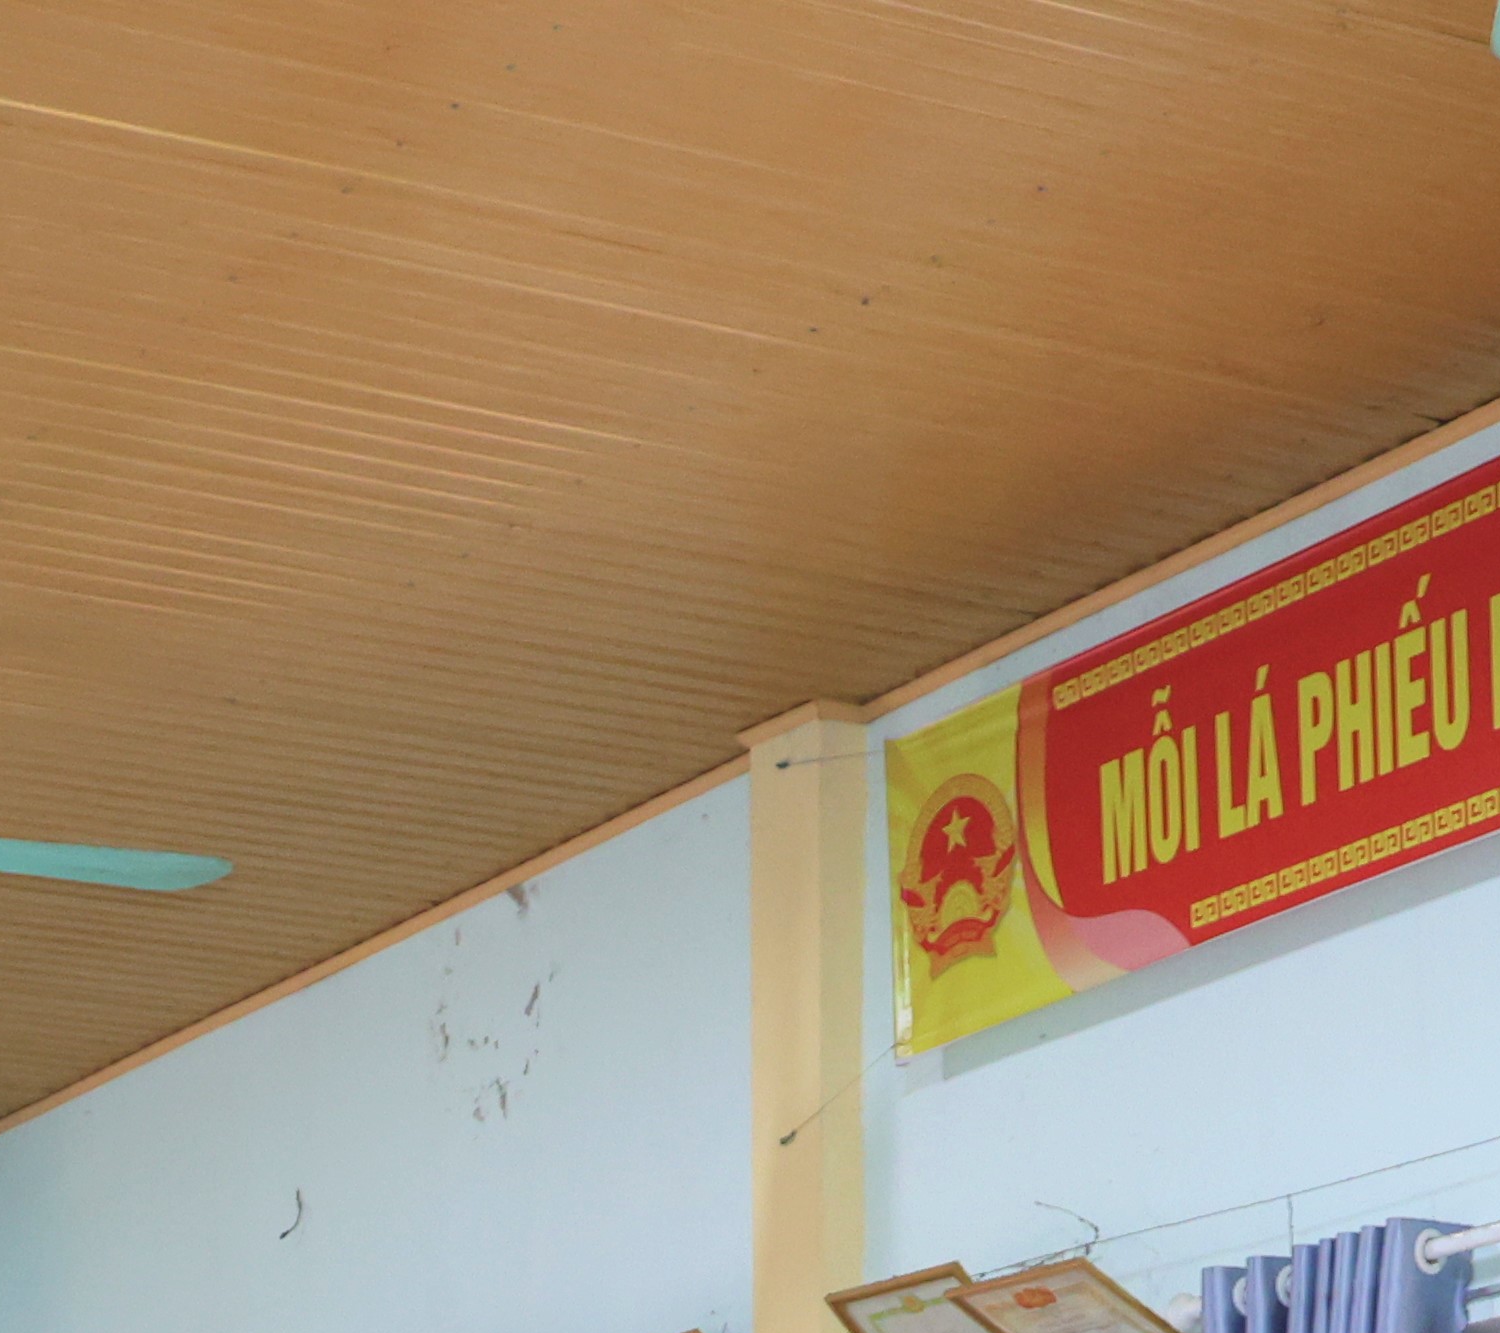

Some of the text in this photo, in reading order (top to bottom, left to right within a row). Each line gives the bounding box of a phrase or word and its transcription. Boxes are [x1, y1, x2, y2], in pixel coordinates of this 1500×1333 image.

[1099, 685, 1200, 885] MỖI
[1214, 664, 1284, 840] LÁ
[1297, 574, 1472, 806] PHIẾU
